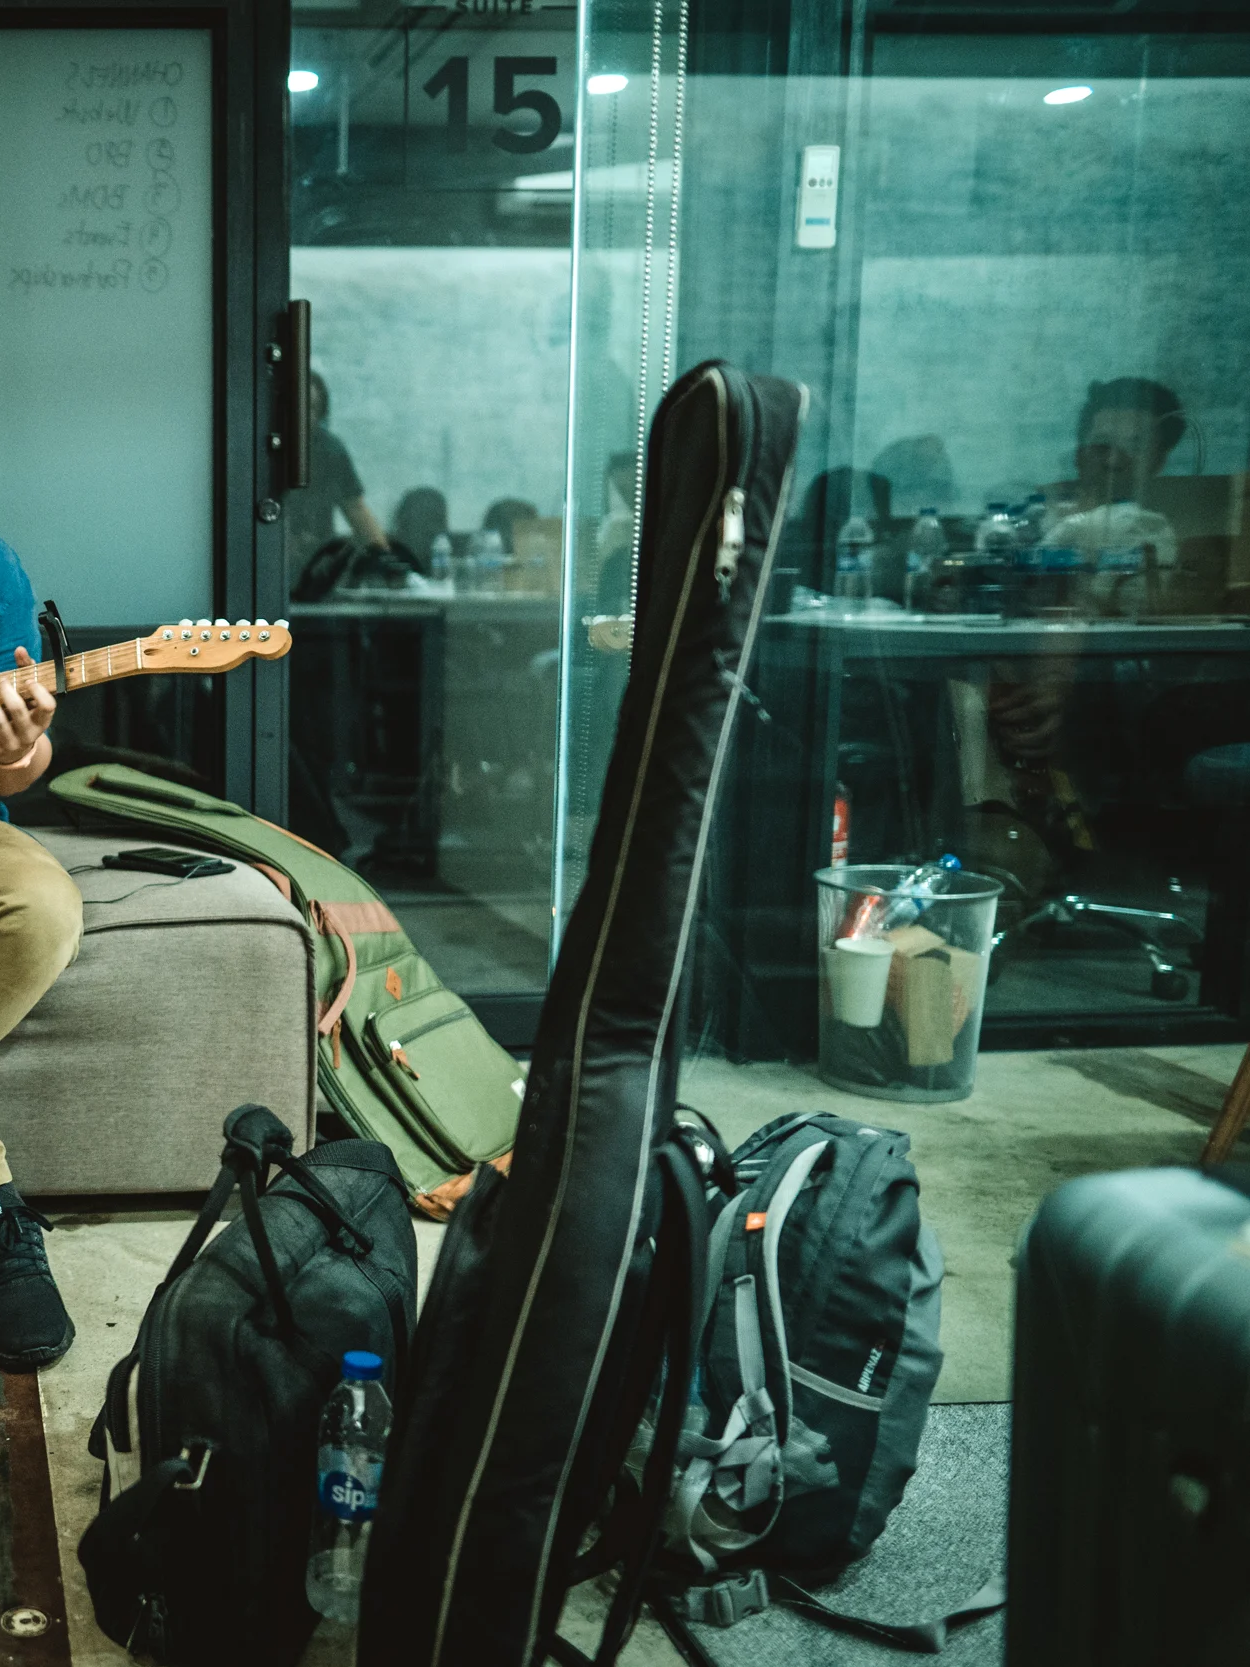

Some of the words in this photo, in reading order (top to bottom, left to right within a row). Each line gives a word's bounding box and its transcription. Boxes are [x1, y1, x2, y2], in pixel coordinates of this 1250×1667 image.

[454, 0, 534, 15] SUITE
[422, 56, 562, 155] 15
[857, 1347, 882, 1393] ARPENAZ
[331, 1477, 366, 1511] sip
